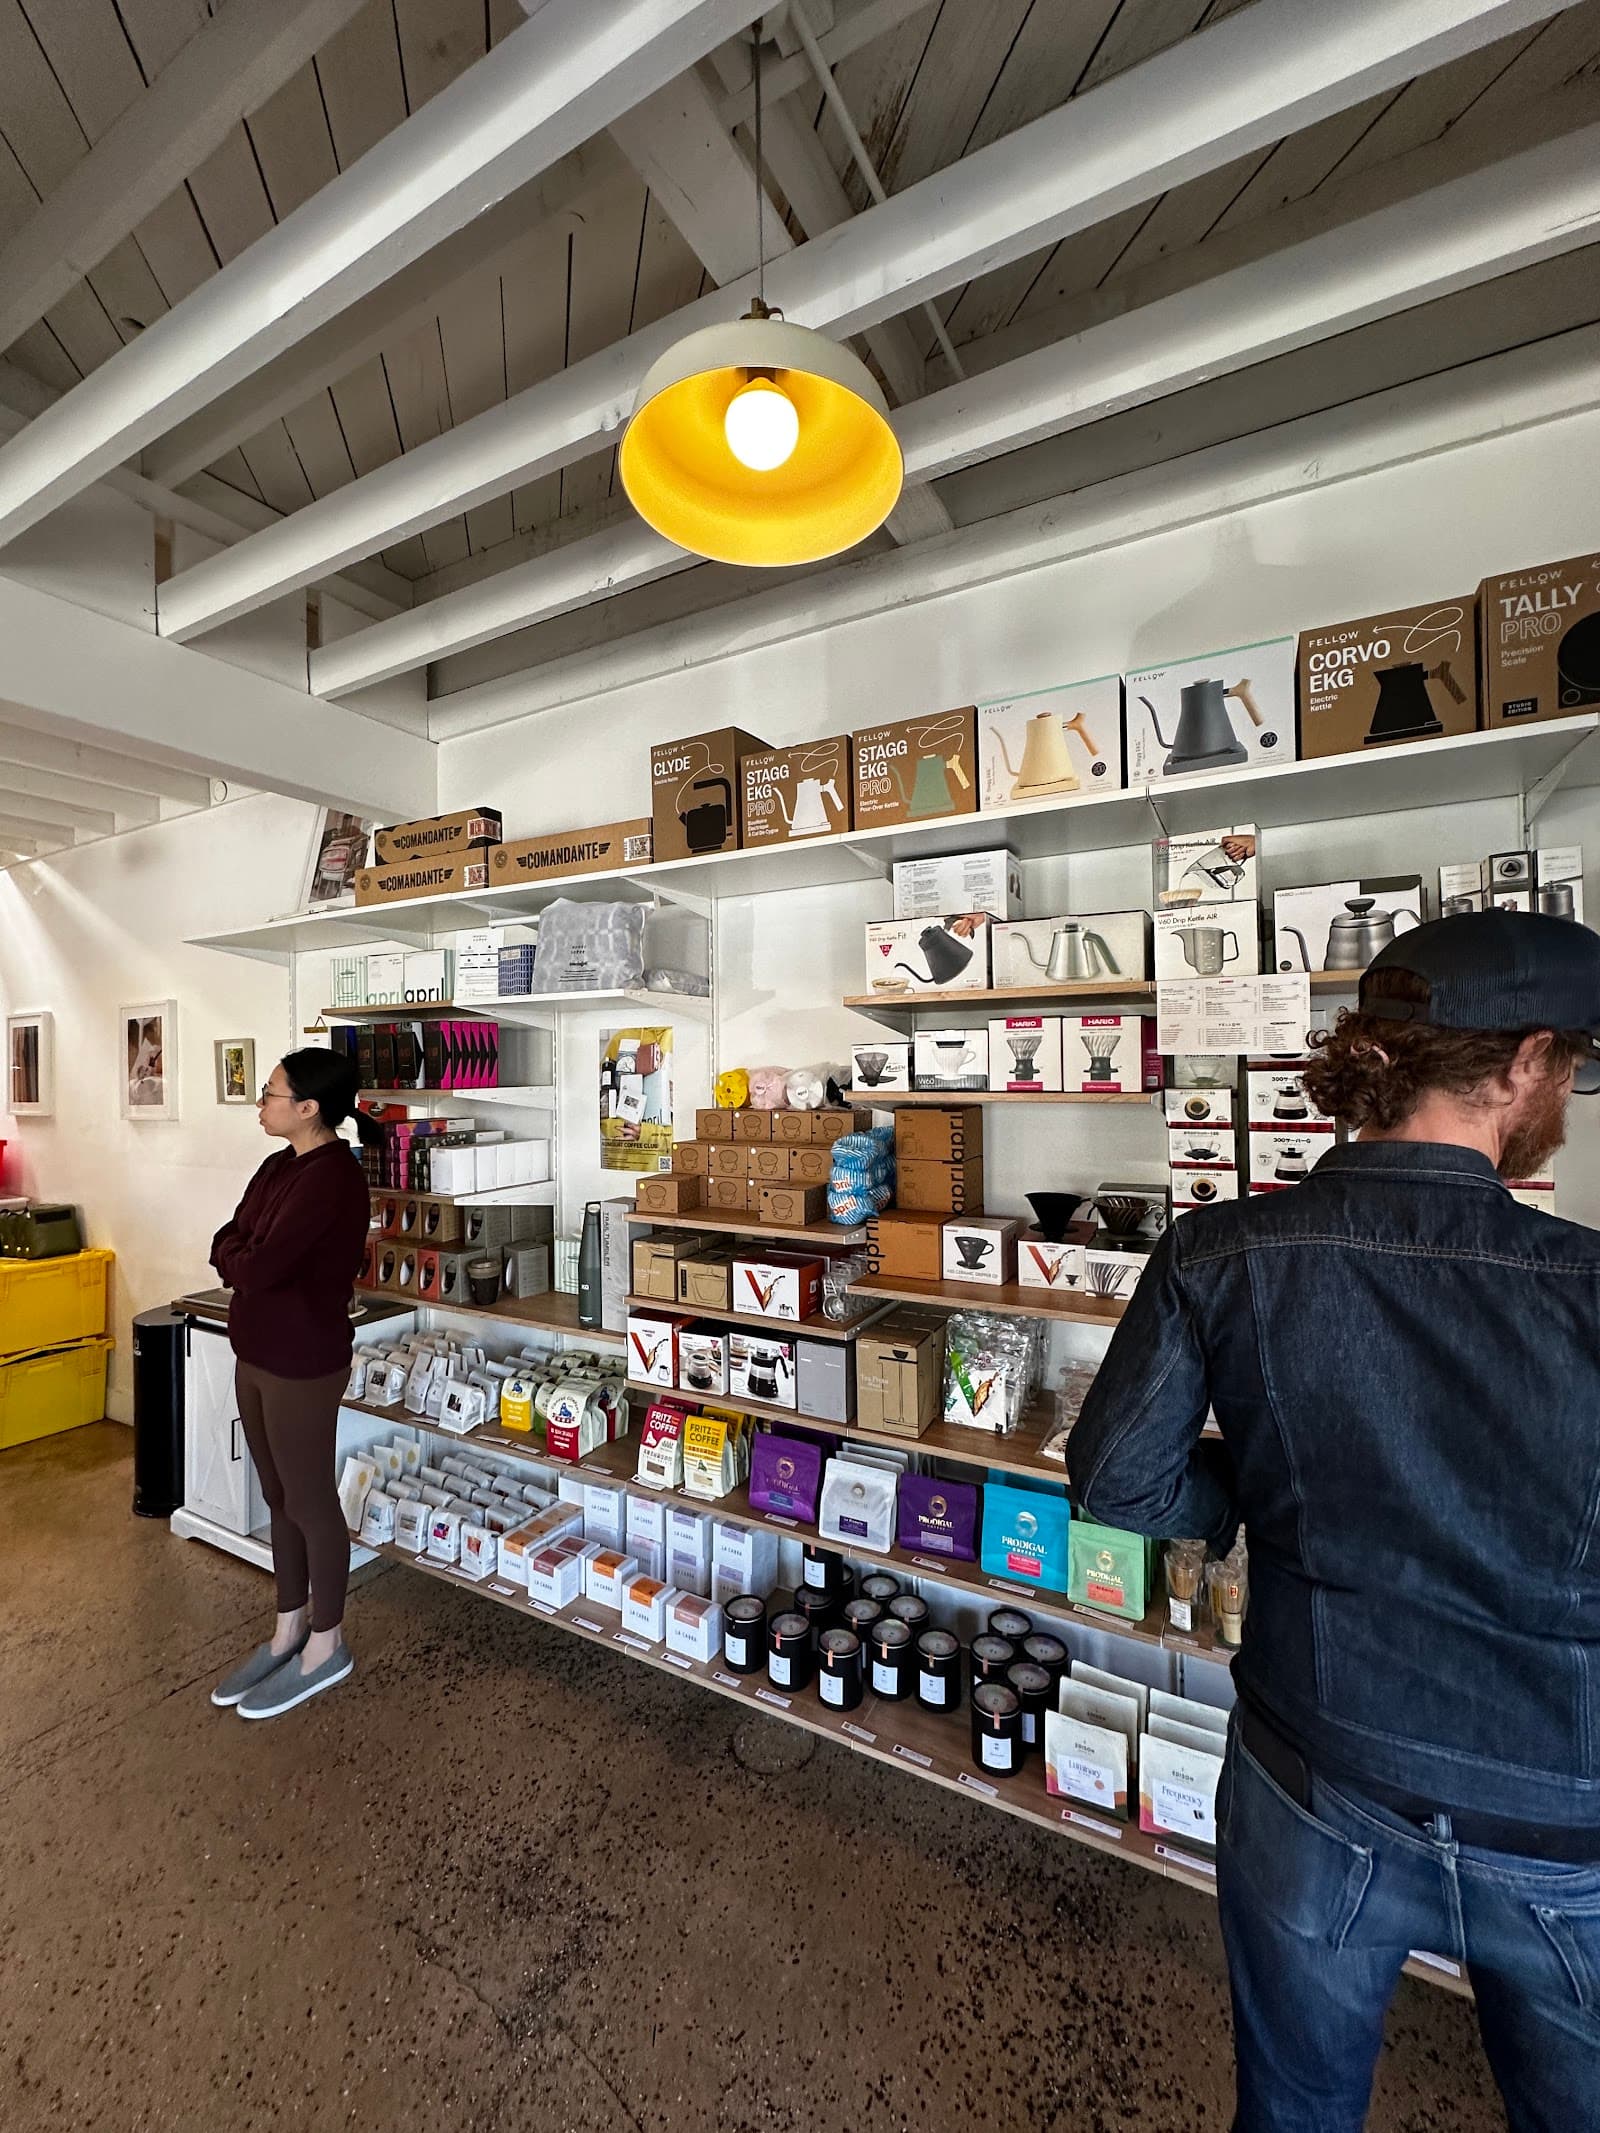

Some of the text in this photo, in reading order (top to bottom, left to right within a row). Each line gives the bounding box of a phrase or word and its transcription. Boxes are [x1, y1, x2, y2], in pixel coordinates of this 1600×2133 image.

[1500, 569, 1563, 590] FELLOW
[1500, 583, 1583, 618] TALLY
[1501, 612, 1562, 644] PRO
[1308, 630, 1360, 648] FELLOW
[1308, 639, 1391, 673] CORVO
[1501, 643, 1544, 658] Precision
[1501, 656, 1527, 668] Scale
[1133, 672, 1165, 683] FELLOW
[1309, 668, 1354, 694] EKG
[1310, 693, 1338, 705] Electric
[1310, 701, 1332, 712] Kettle
[984, 704, 1012, 715] FELLOW
[858, 731, 891, 742] FELLOW
[653, 747, 678, 757] FELLOW
[859, 740, 908, 763] STAGG
[654, 756, 691, 777] CLYDE
[746, 755, 774, 766] FELLOW
[746, 764, 789, 785] STAGG
[860, 761, 888, 780] EKG
[747, 784, 772, 801] EKG
[860, 777, 892, 797] PRO
[747, 799, 776, 818] PRO
[400, 826, 455, 850] COMANDANTE
[527, 841, 600, 870] COMANDANTE
[386, 867, 444, 892] COMANDANTE
[1172, 917, 1186, 926] Drip
[1187, 914, 1205, 923] Kettle
[898, 931, 907, 941] Fit
[404, 977, 444, 1003] april
[1011, 1020, 1037, 1028] HARIO
[1087, 1018, 1115, 1026] HARIO
[832, 1195, 857, 1215] april
[866, 1219, 886, 1275] april
[651, 1410, 672, 1424] FRITZ
[649, 1419, 678, 1435] COFFEE
[690, 1423, 712, 1433] FRITZ
[689, 1432, 720, 1446] COFFEE
[918, 1514, 953, 1529] PRODIGAL
[681, 1532, 694, 1541] CABRA
[728, 1547, 742, 1557] CABRA
[1001, 1535, 1045, 1554] PRODIGAL
[1086, 1568, 1122, 1584] PRODIGAL
[540, 1581, 553, 1591] CABRA
[600, 1583, 613, 1592] CABRA
[636, 1611, 649, 1622] CABRA
[682, 1631, 697, 1642] CABRA
[1074, 1743, 1095, 1753] EDISON
[1068, 1759, 1101, 1778] Luminary
[1171, 1770, 1194, 1782] EDISON
[1162, 1785, 1203, 1806] Frequency
